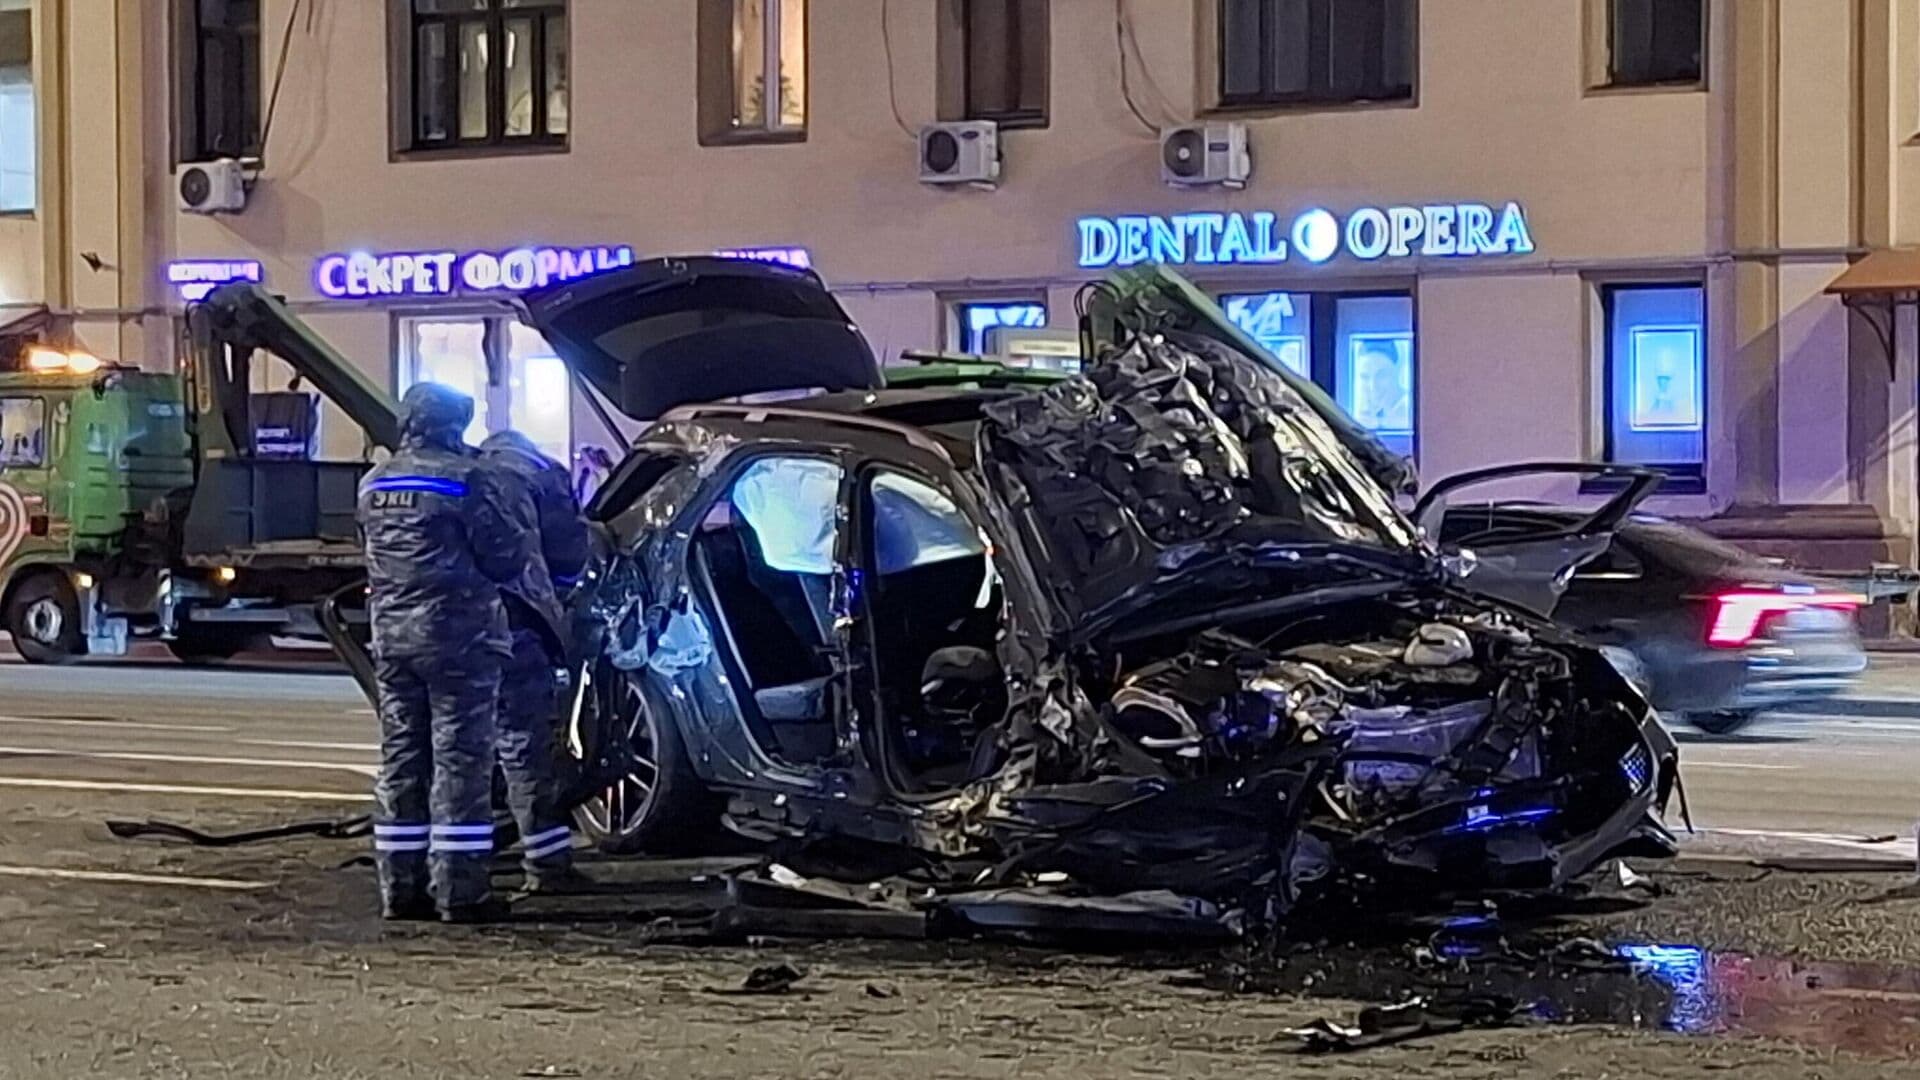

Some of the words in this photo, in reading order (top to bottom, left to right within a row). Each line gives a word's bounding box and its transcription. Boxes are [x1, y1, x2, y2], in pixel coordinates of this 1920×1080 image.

[1078, 211, 1288, 266] DENTAL
[1345, 201, 1535, 259] OPERA
[318, 251, 456, 296] СЕКРЕТ
